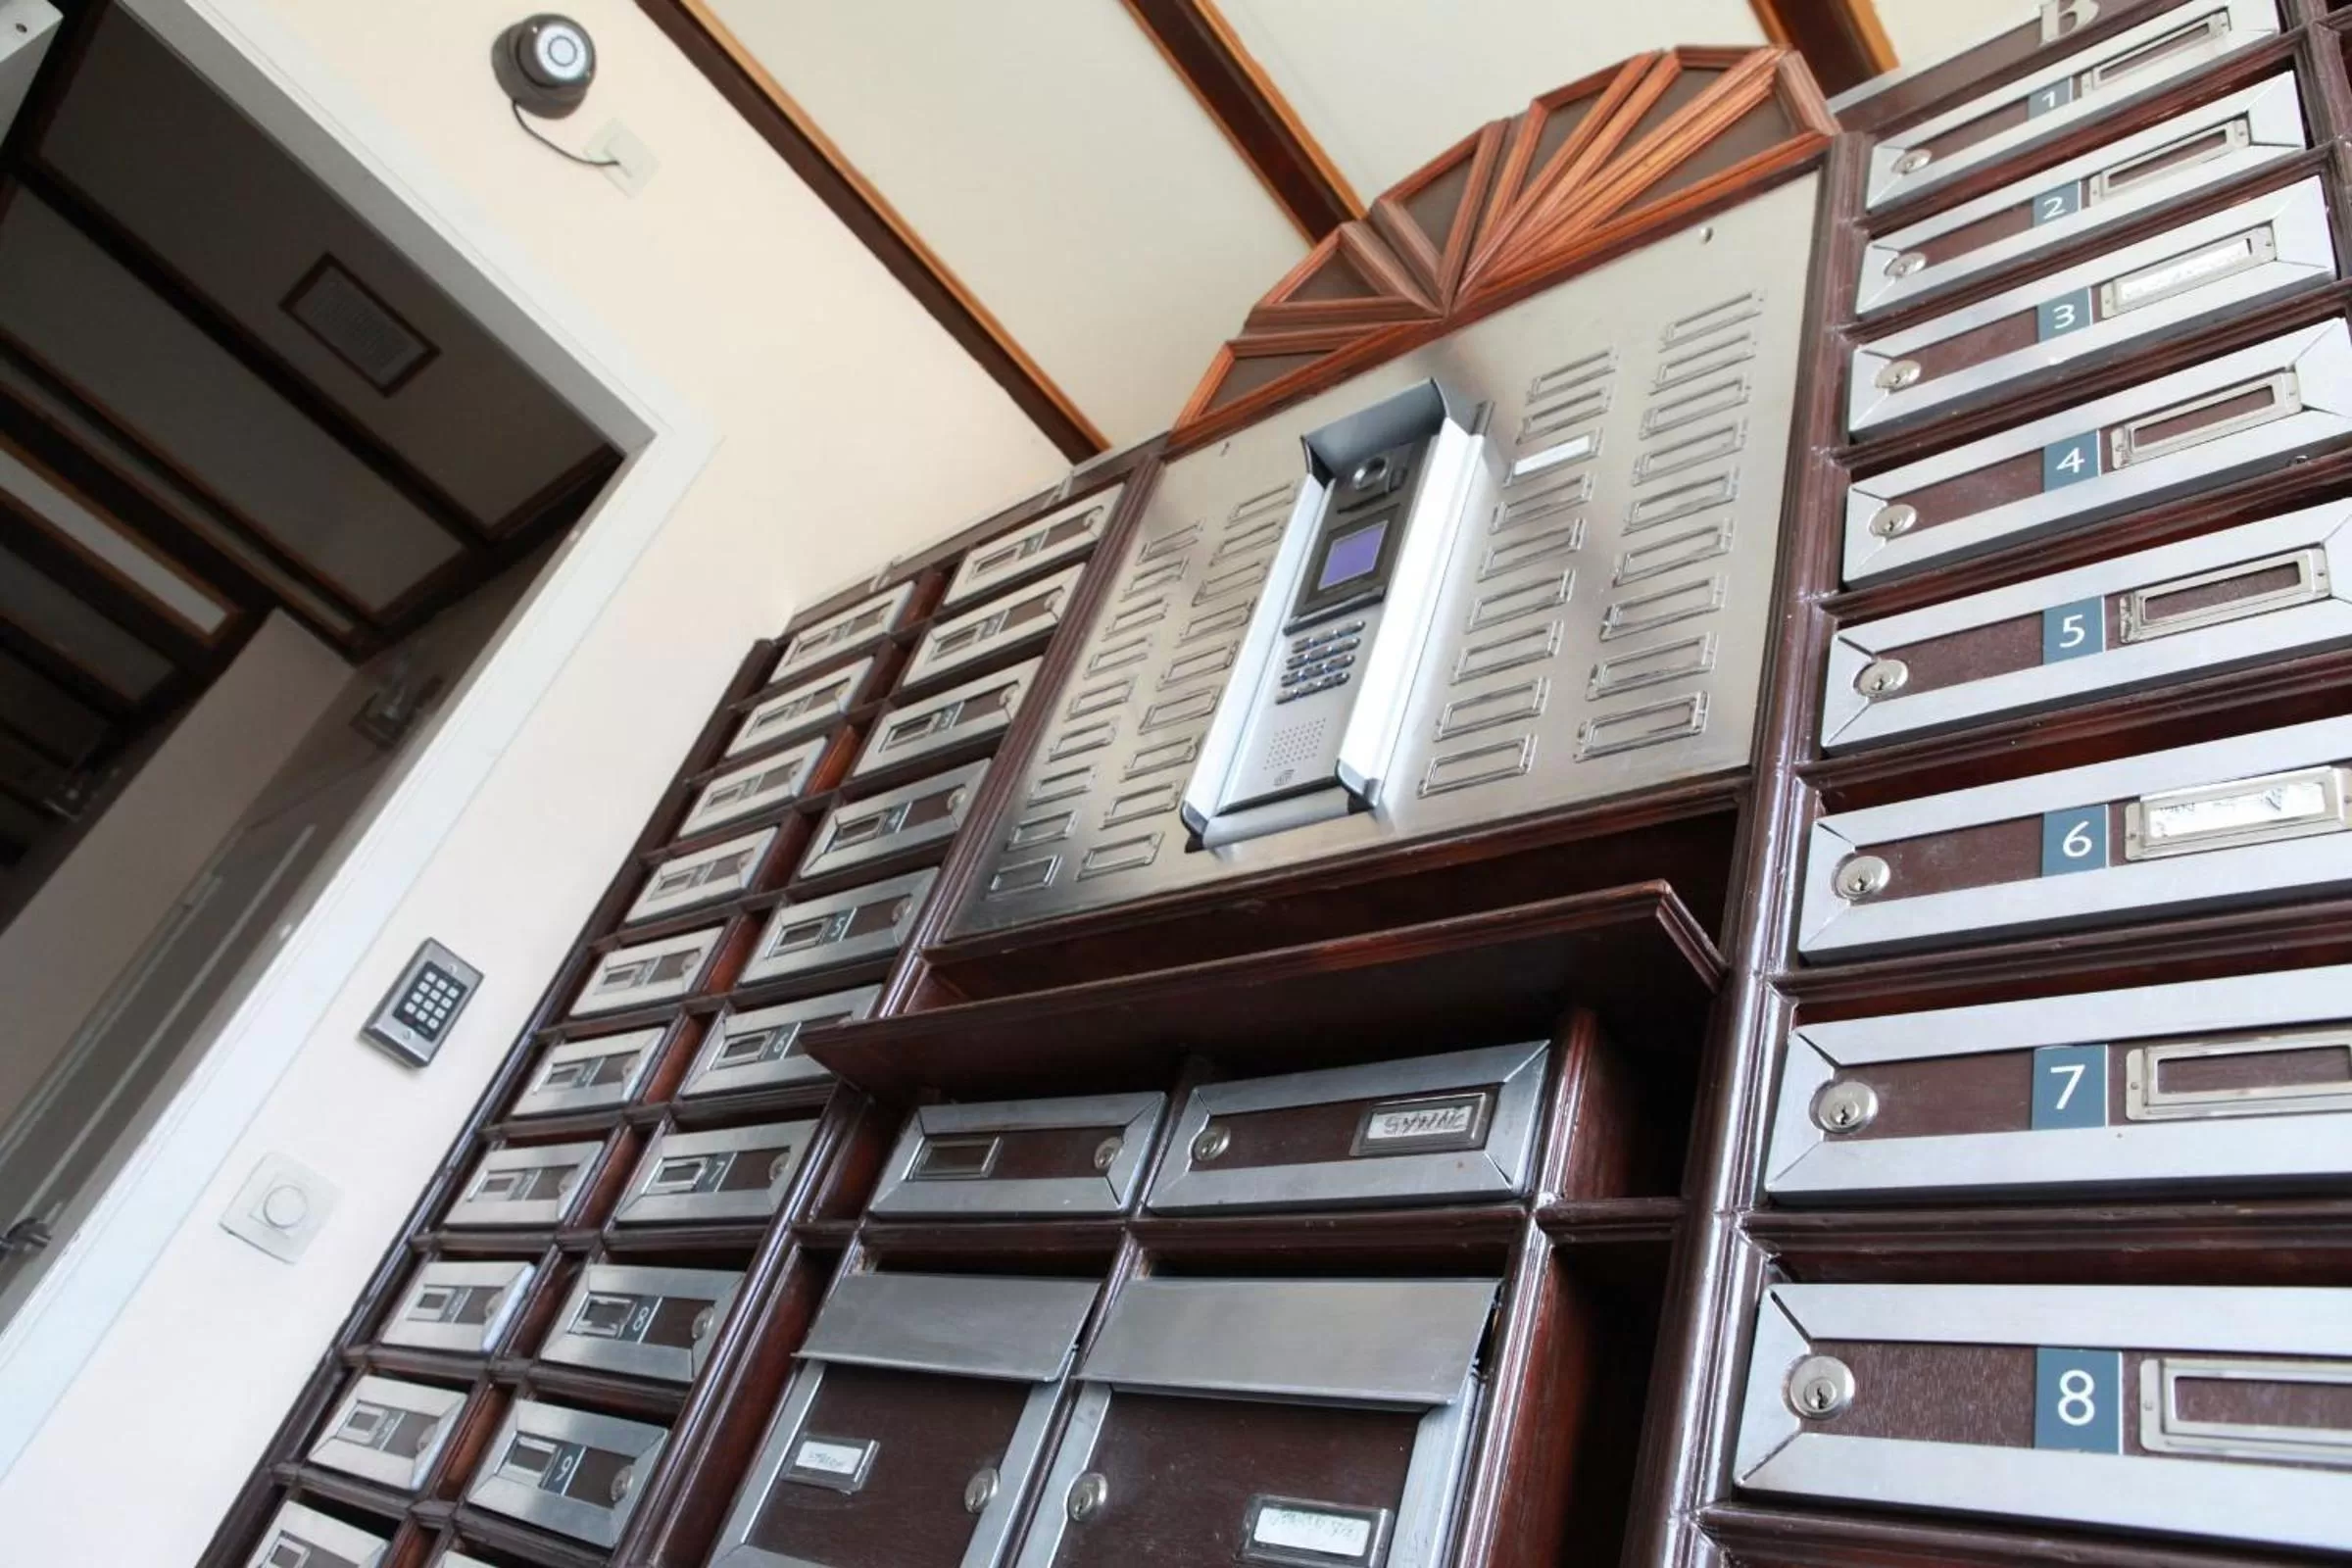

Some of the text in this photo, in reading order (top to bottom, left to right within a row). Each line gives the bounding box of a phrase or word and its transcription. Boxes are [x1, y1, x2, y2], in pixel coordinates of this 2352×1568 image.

[2041, 90, 2056, 108] 1
[2043, 196, 2066, 220] 2
[2053, 304, 2076, 329] 3
[2056, 447, 2085, 474] 4
[2059, 613, 2085, 649] 5
[2062, 820, 2092, 858] 6
[830, 916, 847, 938] 5
[773, 1032, 790, 1054] 6
[2050, 1063, 2085, 1110] 7
[708, 1160, 726, 1185] 7
[632, 1305, 651, 1332] 8
[2057, 1369, 2095, 1426] 8
[554, 1455, 573, 1483] 9
